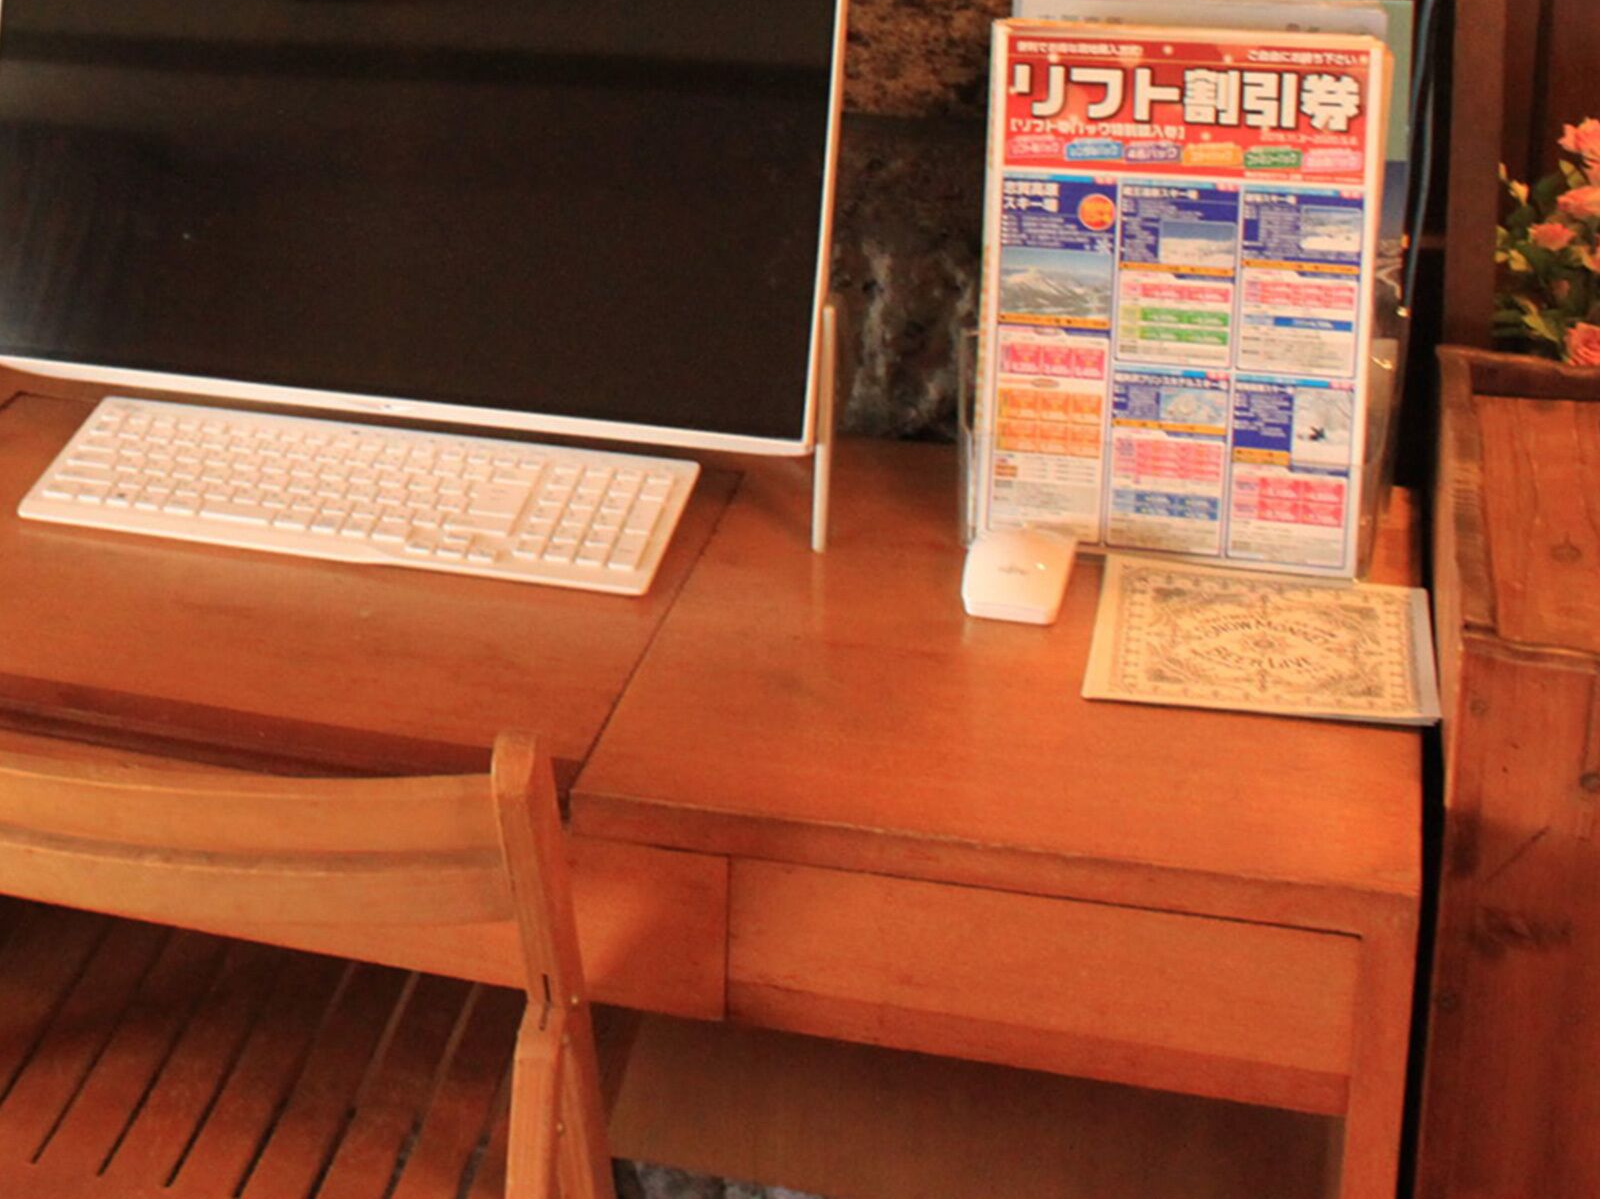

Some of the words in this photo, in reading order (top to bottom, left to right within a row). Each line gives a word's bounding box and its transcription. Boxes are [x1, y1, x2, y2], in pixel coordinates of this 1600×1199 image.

[1014, 62, 1361, 132] リフト割引券
